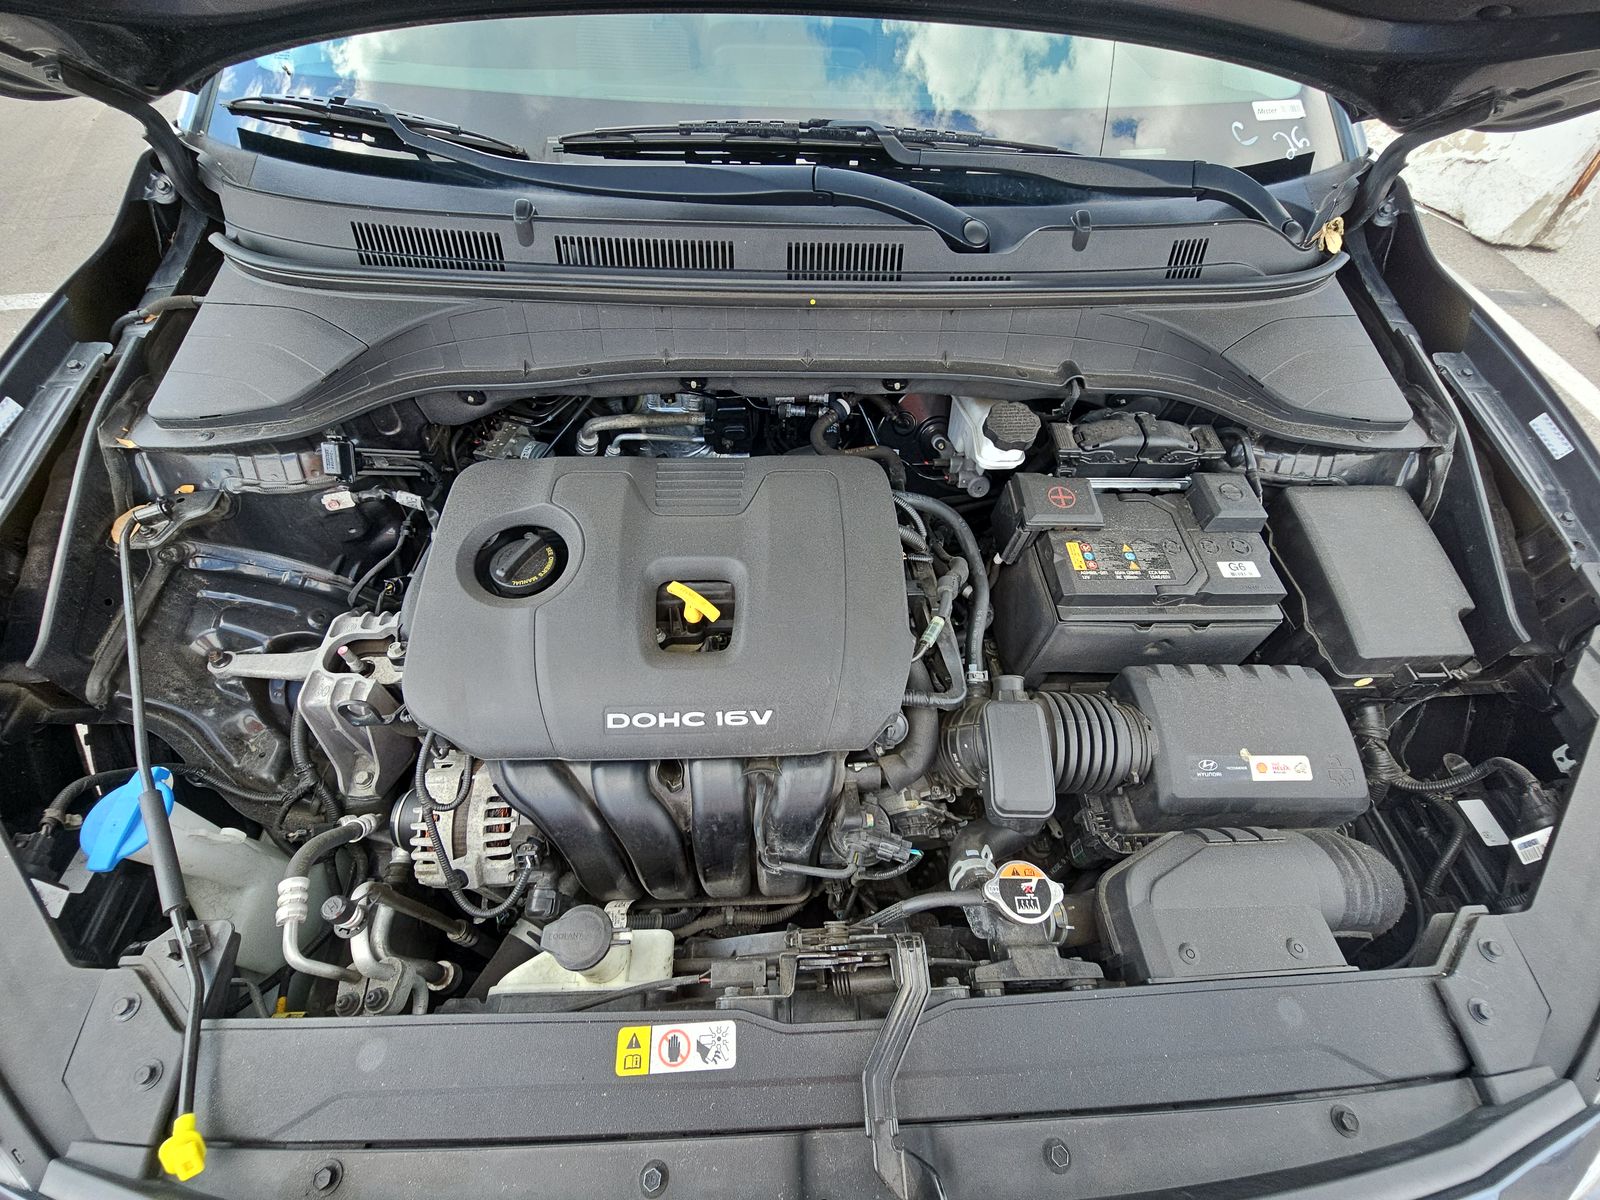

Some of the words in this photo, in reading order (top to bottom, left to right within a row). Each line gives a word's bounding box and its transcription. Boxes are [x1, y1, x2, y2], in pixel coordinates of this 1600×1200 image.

[546, 547, 554, 556] SEE
[1228, 562, 1247, 572] G6
[512, 576, 538, 586] MANUAL
[606, 711, 706, 729] DOHC
[715, 709, 774, 727] 16V
